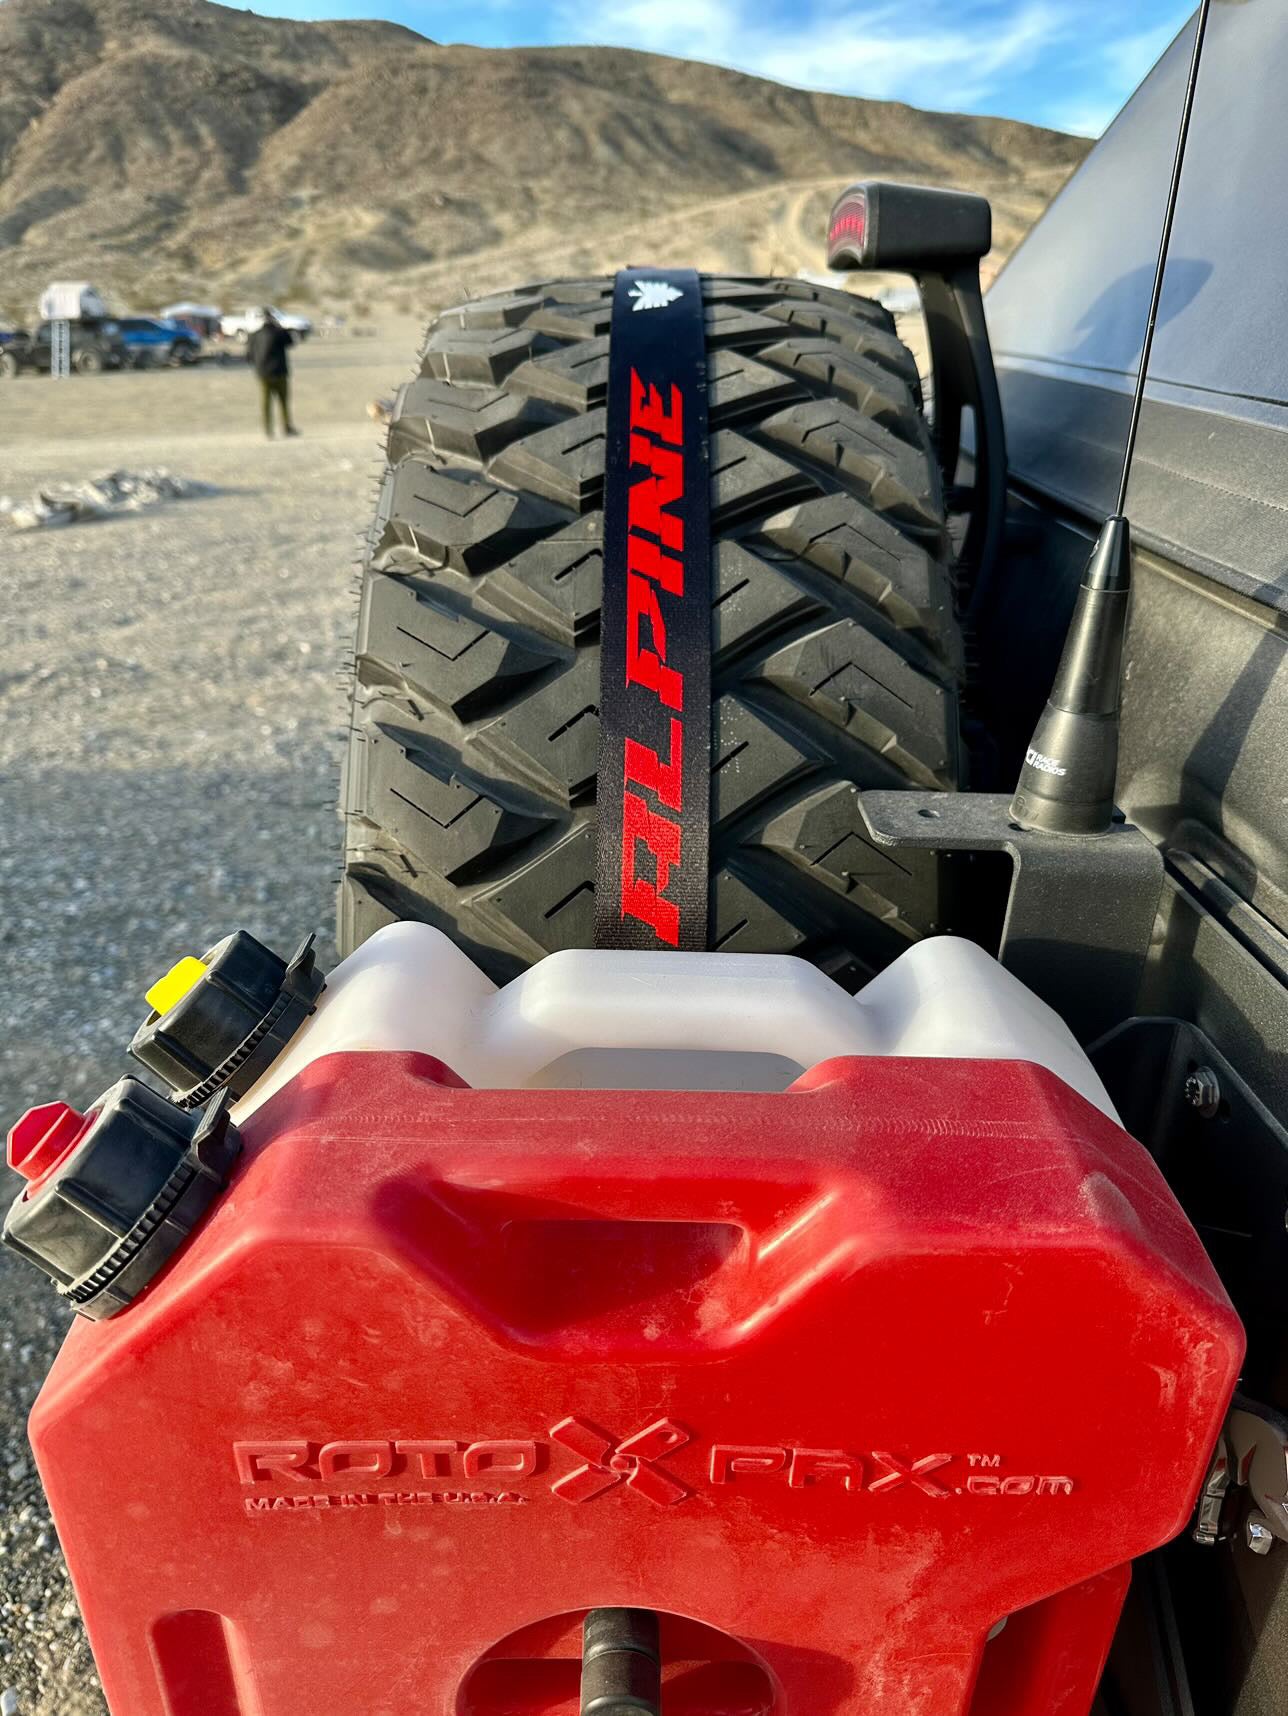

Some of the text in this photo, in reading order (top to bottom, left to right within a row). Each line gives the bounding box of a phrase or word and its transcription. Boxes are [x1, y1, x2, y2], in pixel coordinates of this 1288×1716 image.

[621, 366, 684, 947] ALPINE
[1033, 761, 1067, 775] RADIOS
[245, 1495, 330, 1511] MADE
[340, 1494, 368, 1507] IN
[378, 1492, 434, 1505] THE
